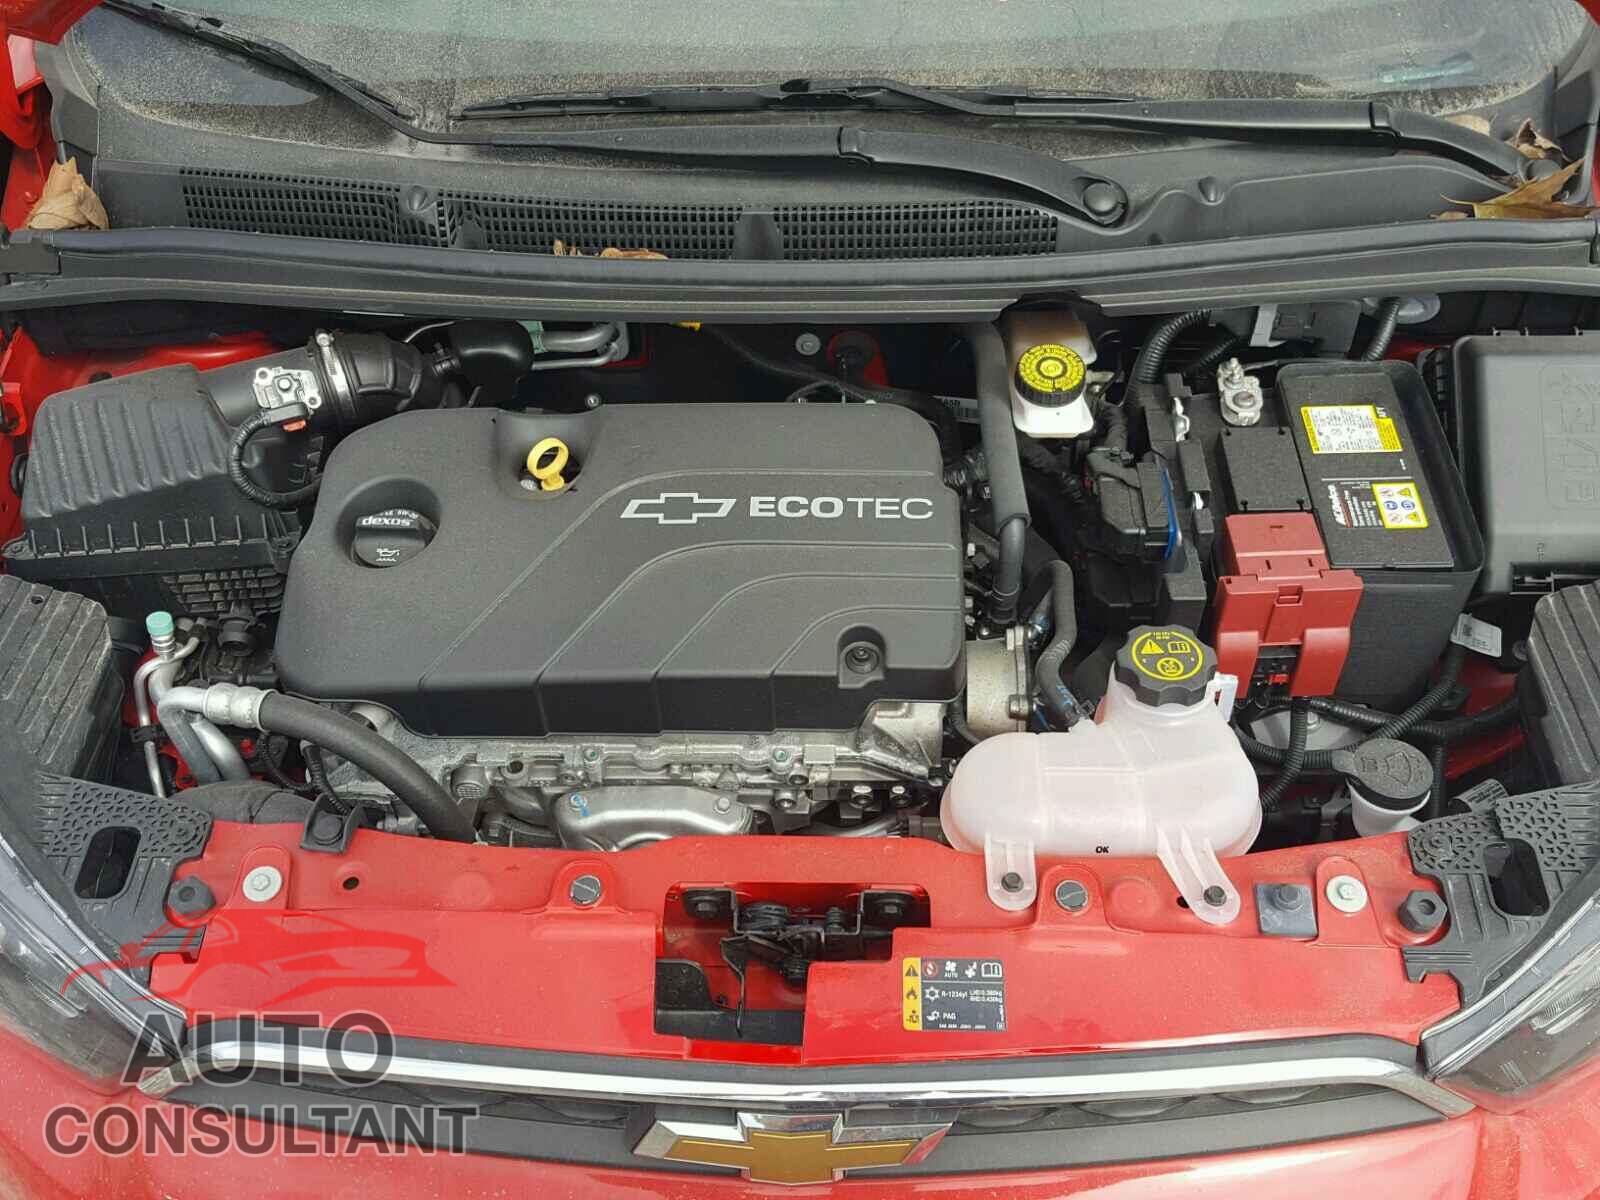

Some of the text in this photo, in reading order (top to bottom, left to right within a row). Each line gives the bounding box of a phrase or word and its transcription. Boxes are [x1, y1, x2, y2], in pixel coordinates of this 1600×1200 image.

[750, 496, 934, 520] ECOTEC
[362, 515, 411, 527] dexos
[1095, 845, 1110, 854] OK
[942, 1012, 957, 1020] PAG
